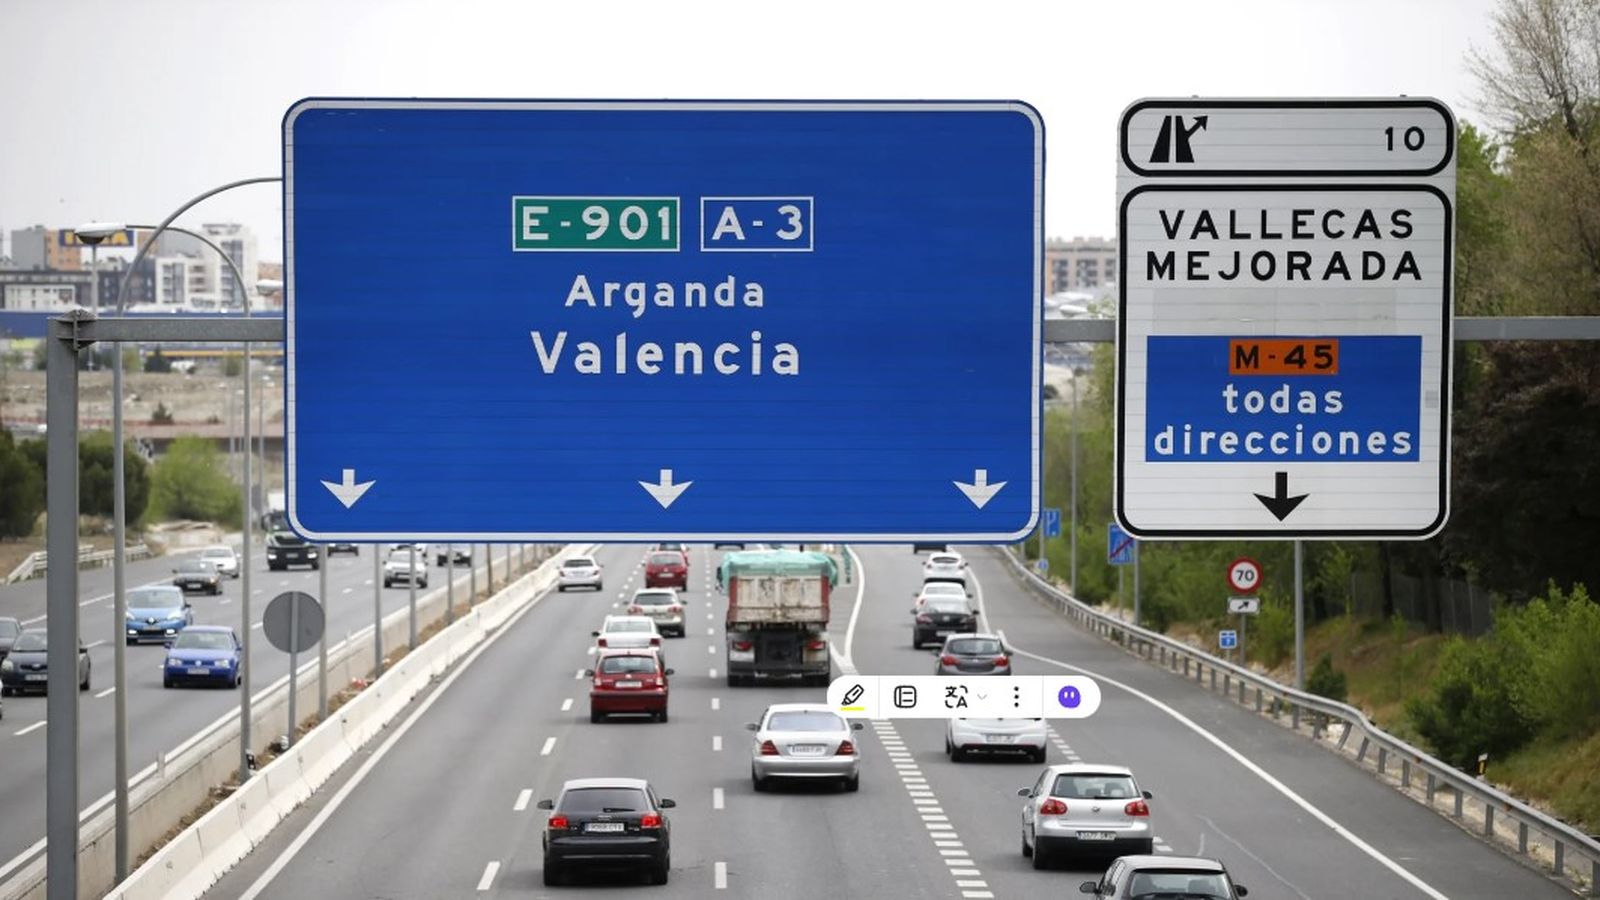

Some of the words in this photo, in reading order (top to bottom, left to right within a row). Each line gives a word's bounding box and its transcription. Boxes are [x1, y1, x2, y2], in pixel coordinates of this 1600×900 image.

[1384, 126, 1425, 152] 10
[522, 205, 670, 241] E-901
[711, 204, 803, 241] A-3
[1158, 208, 1414, 240] VALLECAS
[1146, 250, 1423, 282] MEJORADA
[564, 274, 765, 319] Arganda
[530, 330, 800, 375] Valencia
[1235, 344, 1334, 370] M-45
[1222, 383, 1344, 414] todas
[1153, 423, 1412, 455] direcciones
[1236, 569, 1256, 582] 70
